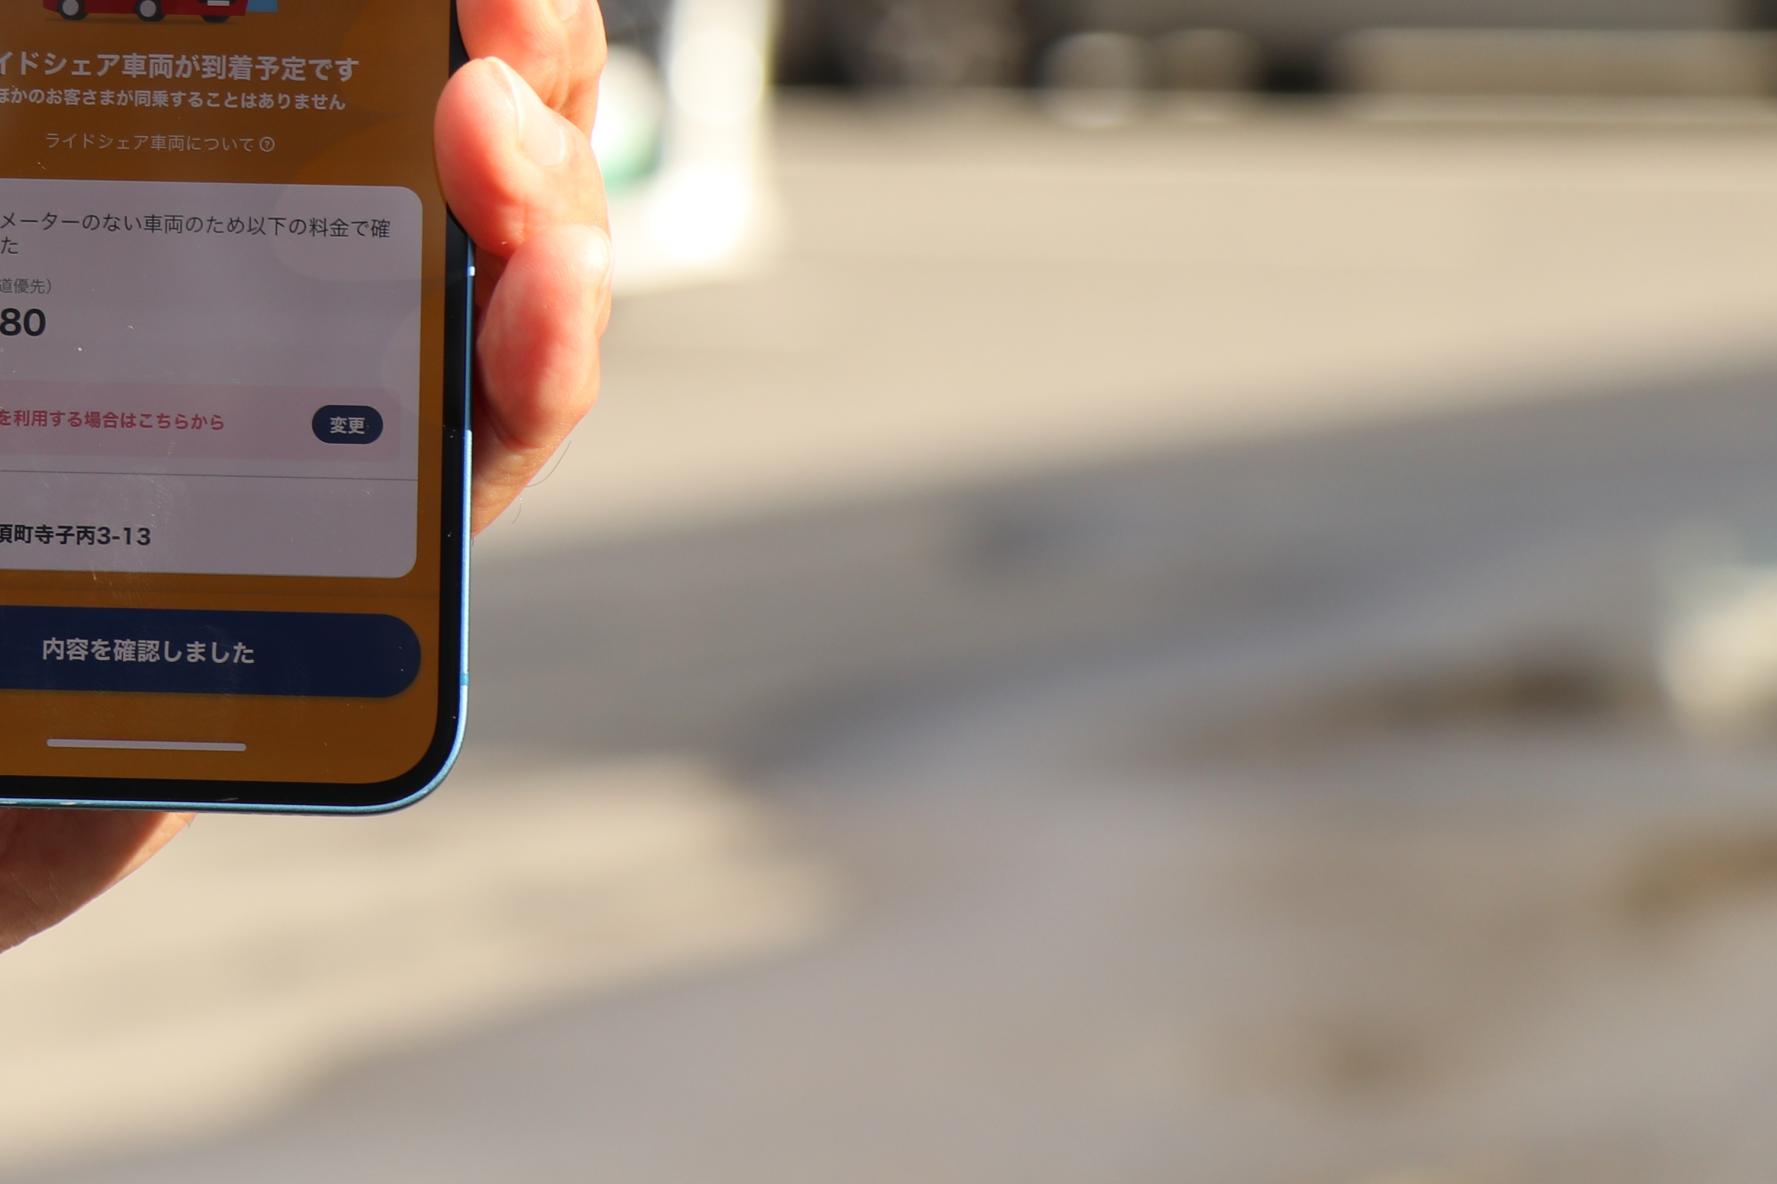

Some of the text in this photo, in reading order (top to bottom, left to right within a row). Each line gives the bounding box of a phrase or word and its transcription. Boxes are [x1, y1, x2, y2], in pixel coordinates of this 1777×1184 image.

[45, 132, 255, 153] ライドシェア車両について
[329, 417, 366, 436] 変更
[42, 636, 255, 665] 内容を確認しました
